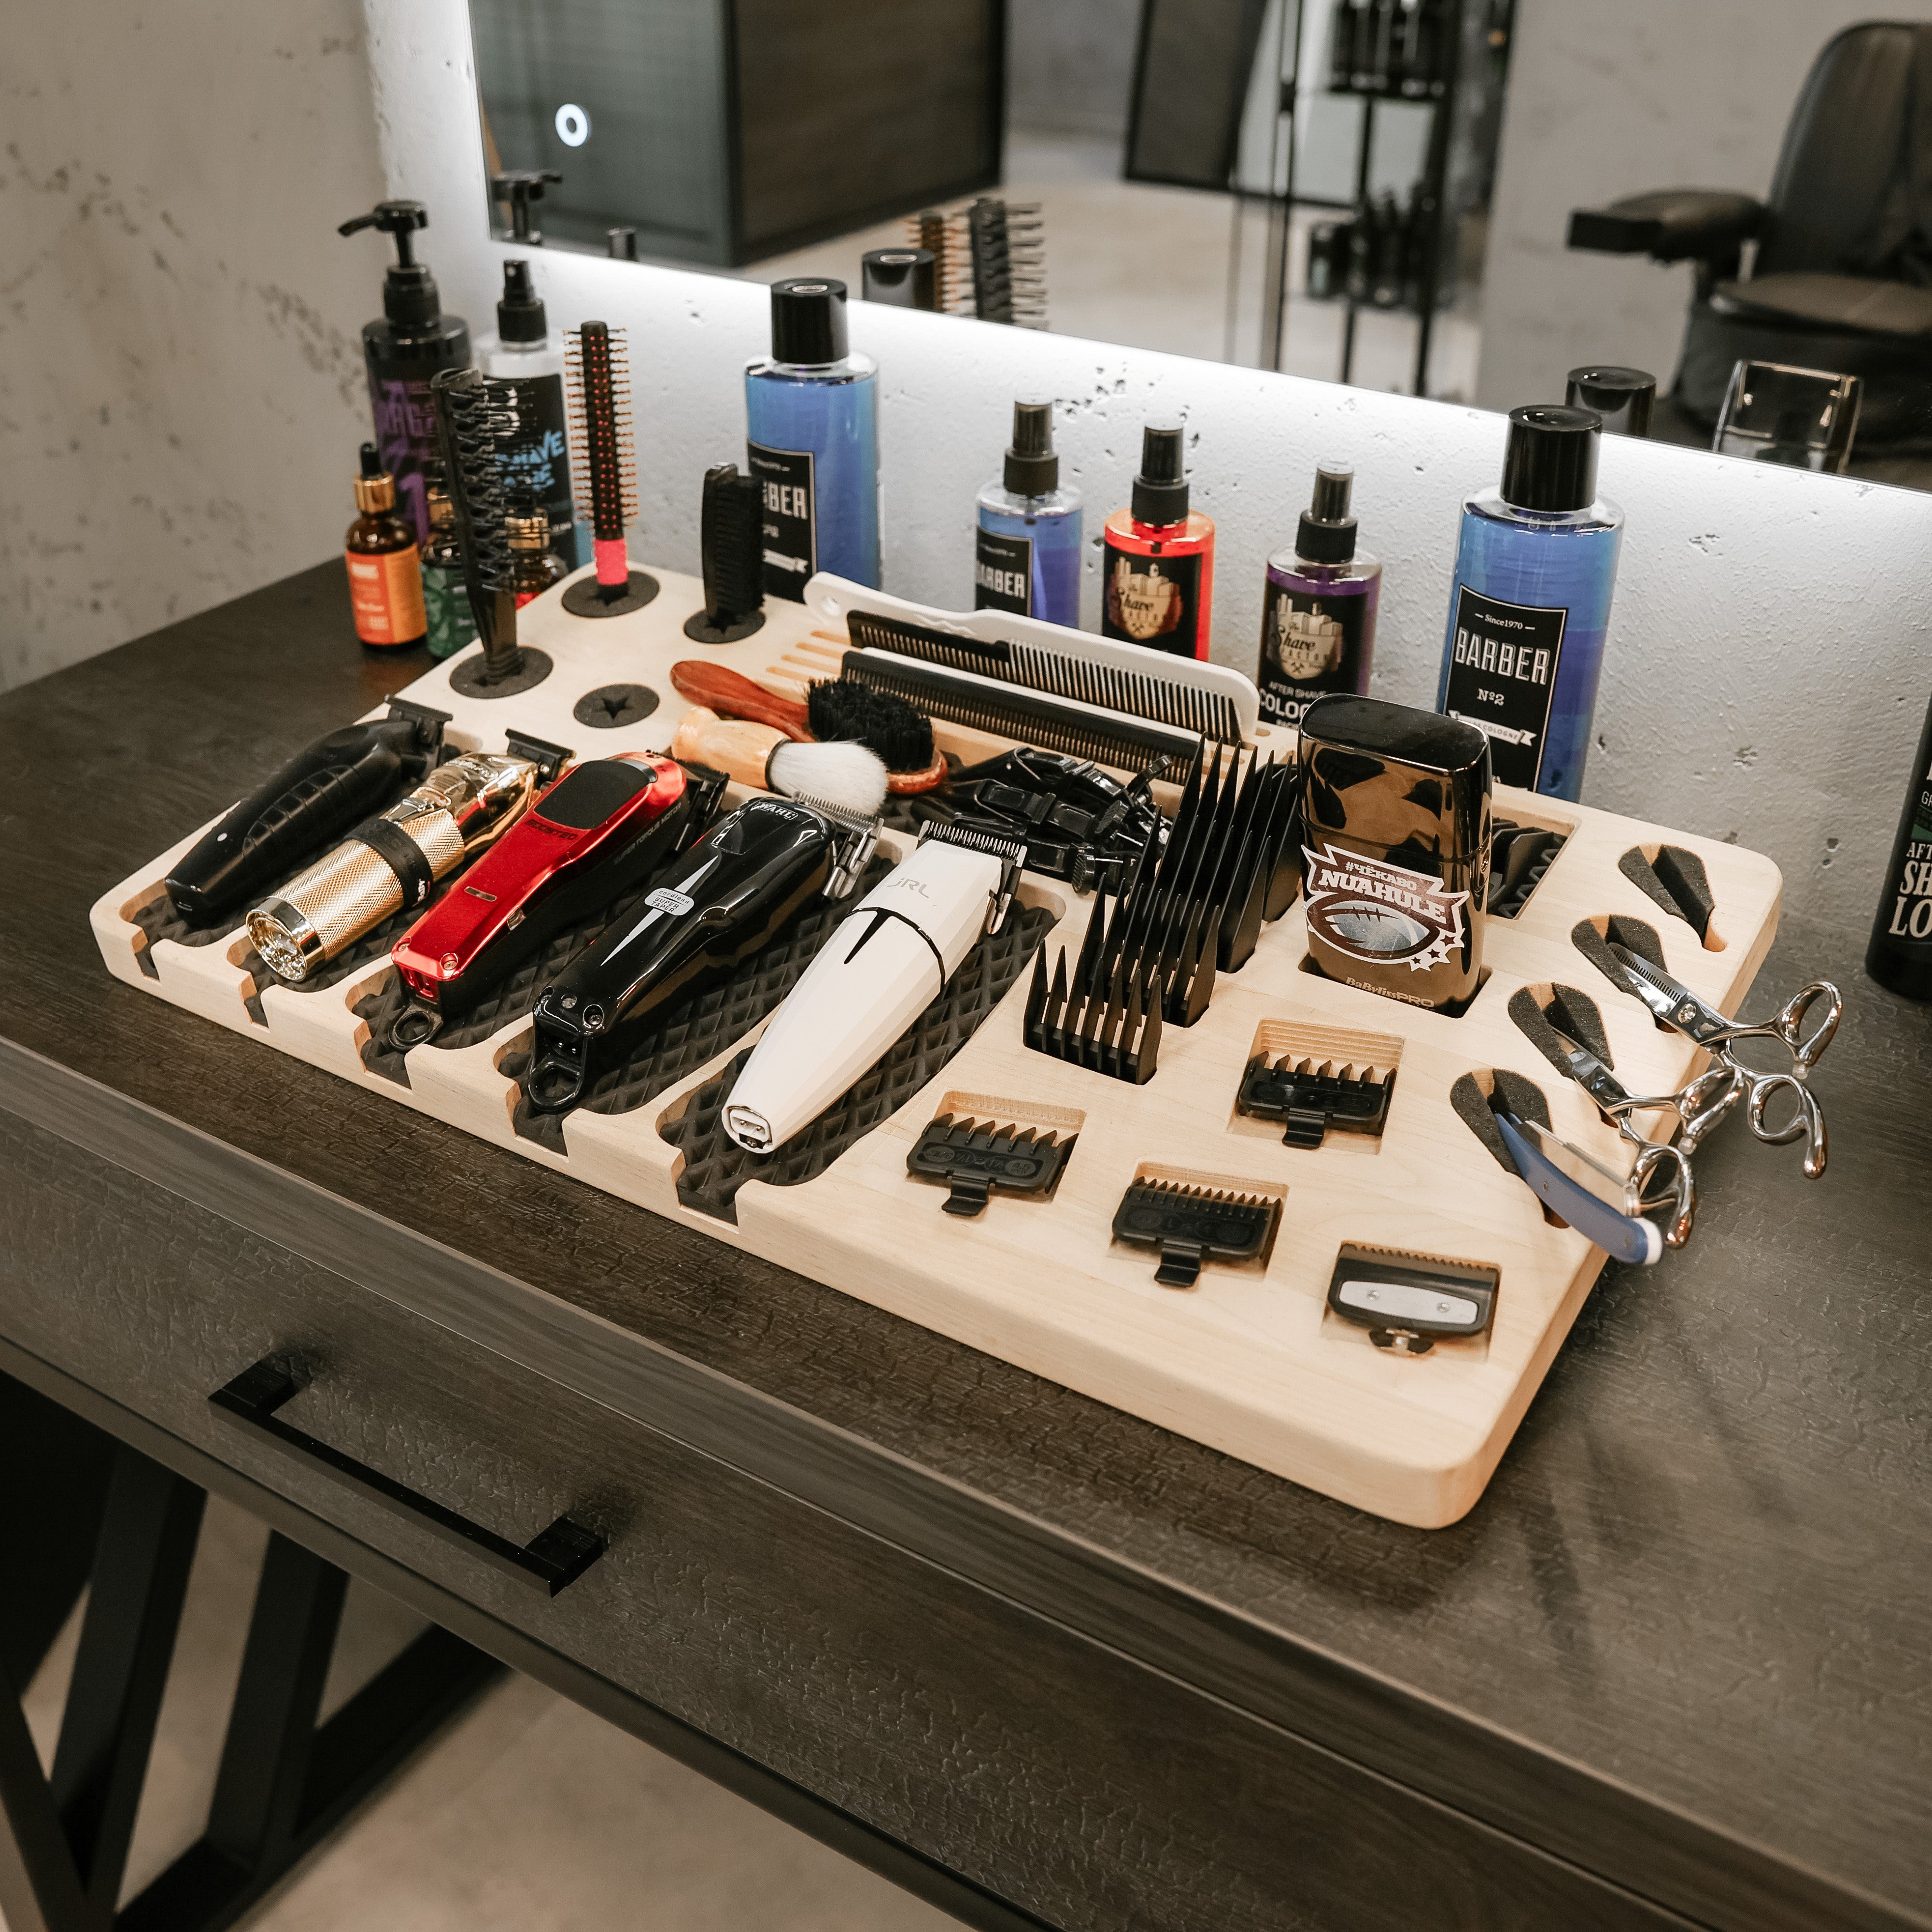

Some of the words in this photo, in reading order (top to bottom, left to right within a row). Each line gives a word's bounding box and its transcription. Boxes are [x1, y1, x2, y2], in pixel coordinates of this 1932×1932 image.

[1484, 613, 1523, 630] Since1970
[1455, 626, 1551, 686] BARBER
[1269, 681, 1294, 696] AFTER
[751, 802, 793, 819] WAHL
[654, 897, 679, 909] SUPER
[659, 890, 690, 904] cordless
[651, 901, 675, 912] TAPER
[1888, 895, 1932, 938] LO
[1345, 976, 1435, 1008] BaBylissPRO
